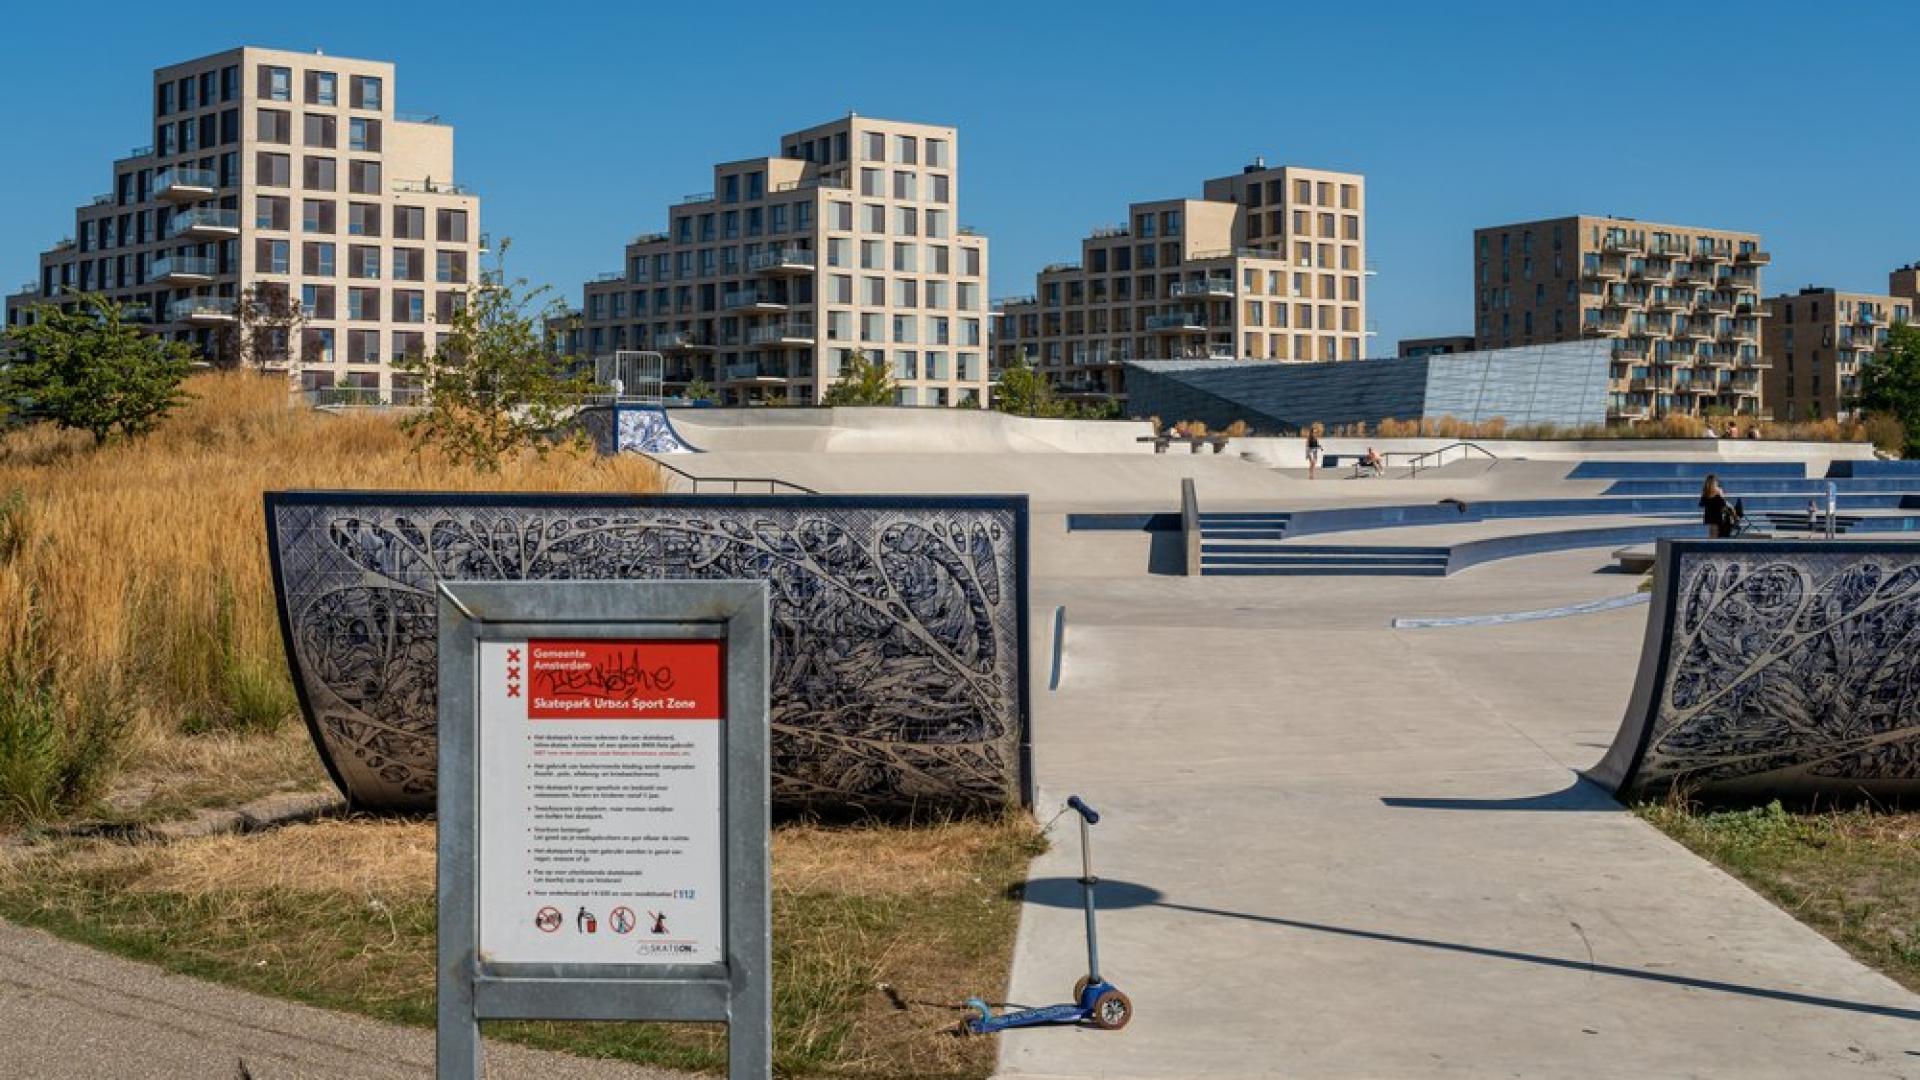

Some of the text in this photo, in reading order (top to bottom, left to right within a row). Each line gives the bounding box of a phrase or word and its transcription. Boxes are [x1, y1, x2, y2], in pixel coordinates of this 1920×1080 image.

[534, 649, 586, 659] Gemeente
[534, 660, 592, 670] Amsterdam
[534, 698, 590, 711] Skatepark
[632, 698, 663, 711] Sport
[667, 698, 696, 709] Zone
